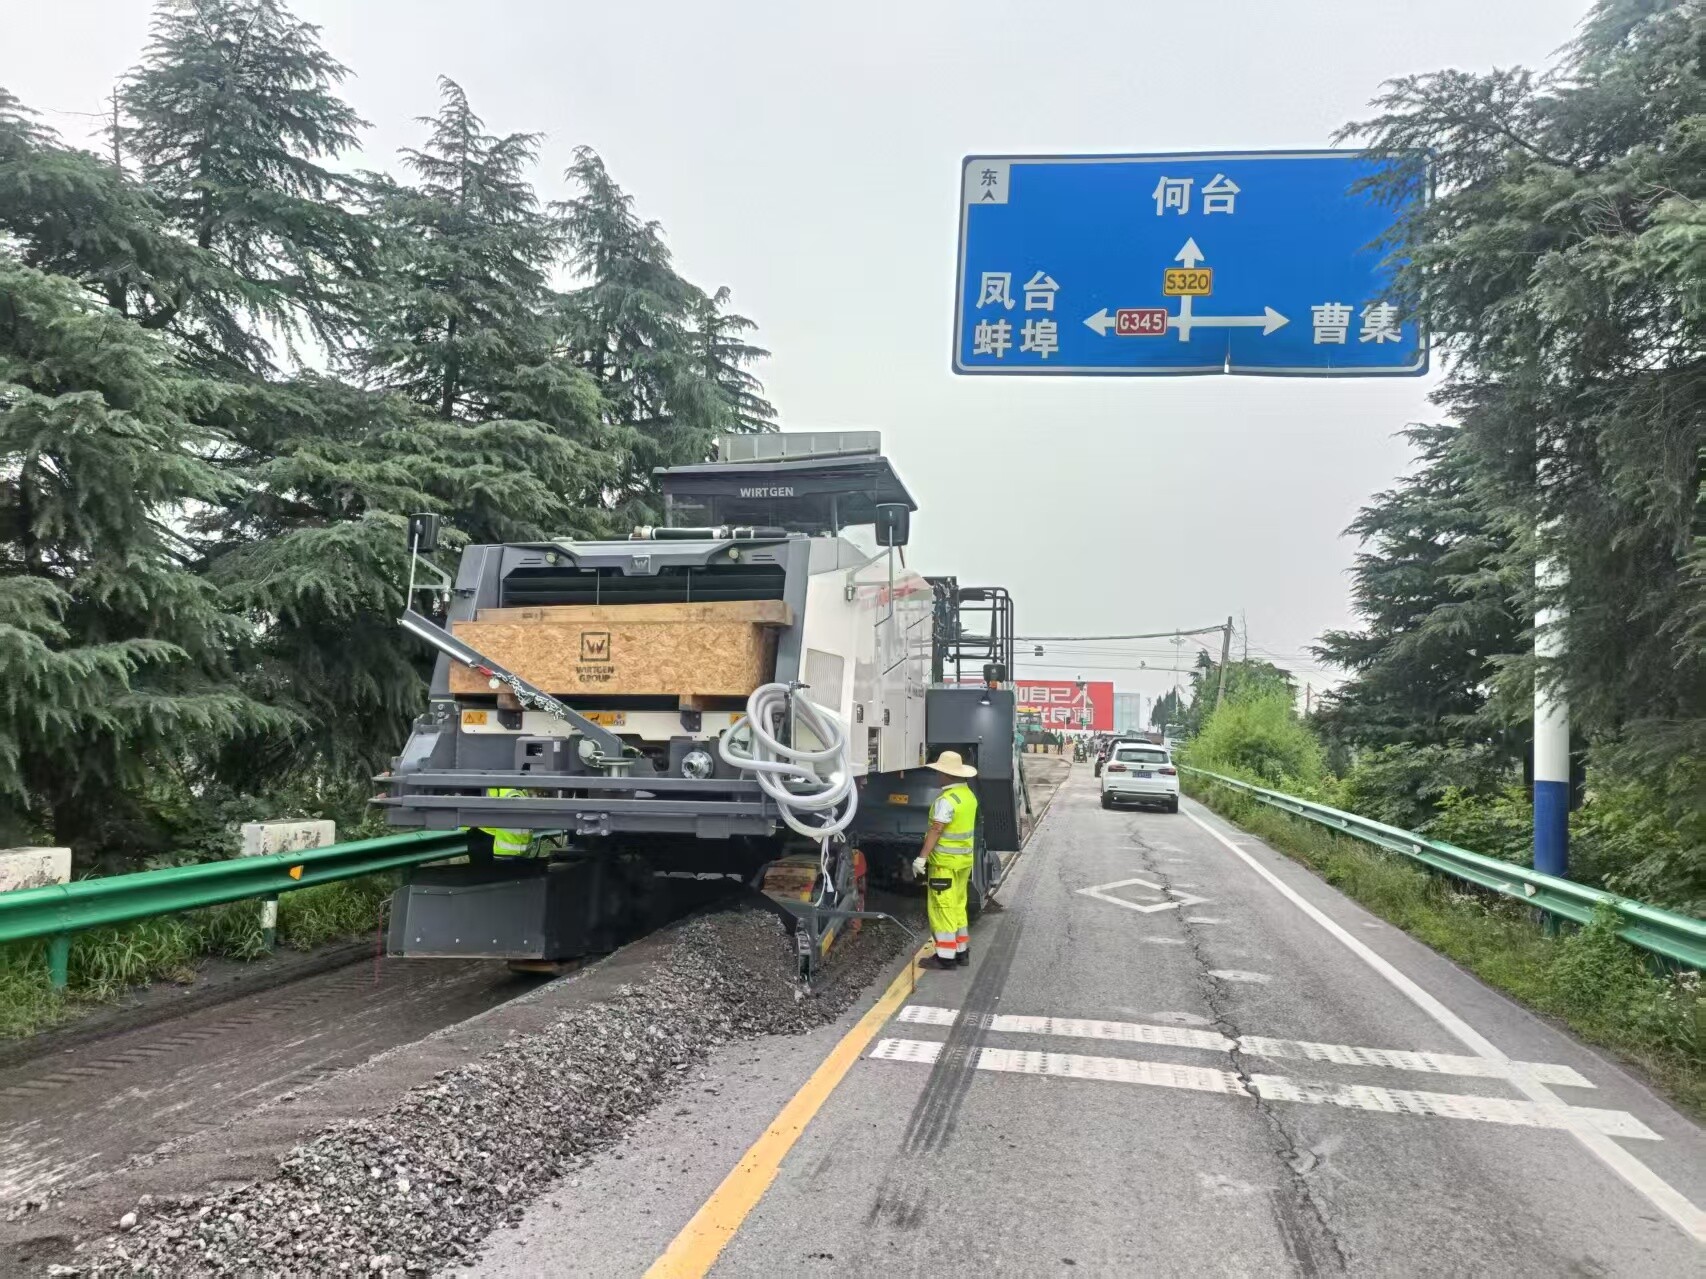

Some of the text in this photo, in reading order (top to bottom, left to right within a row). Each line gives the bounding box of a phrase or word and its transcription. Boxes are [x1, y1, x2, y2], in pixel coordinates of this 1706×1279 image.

[981, 168, 998, 187] 东
[1152, 173, 1241, 216] 何台
[976, 270, 1060, 311] 凤台
[1166, 274, 1209, 290] S320
[1120, 313, 1163, 330] G345
[1311, 302, 1402, 344] 曹集
[973, 318, 1059, 359] 蚌埠
[740, 486, 794, 498] WIRTGEN
